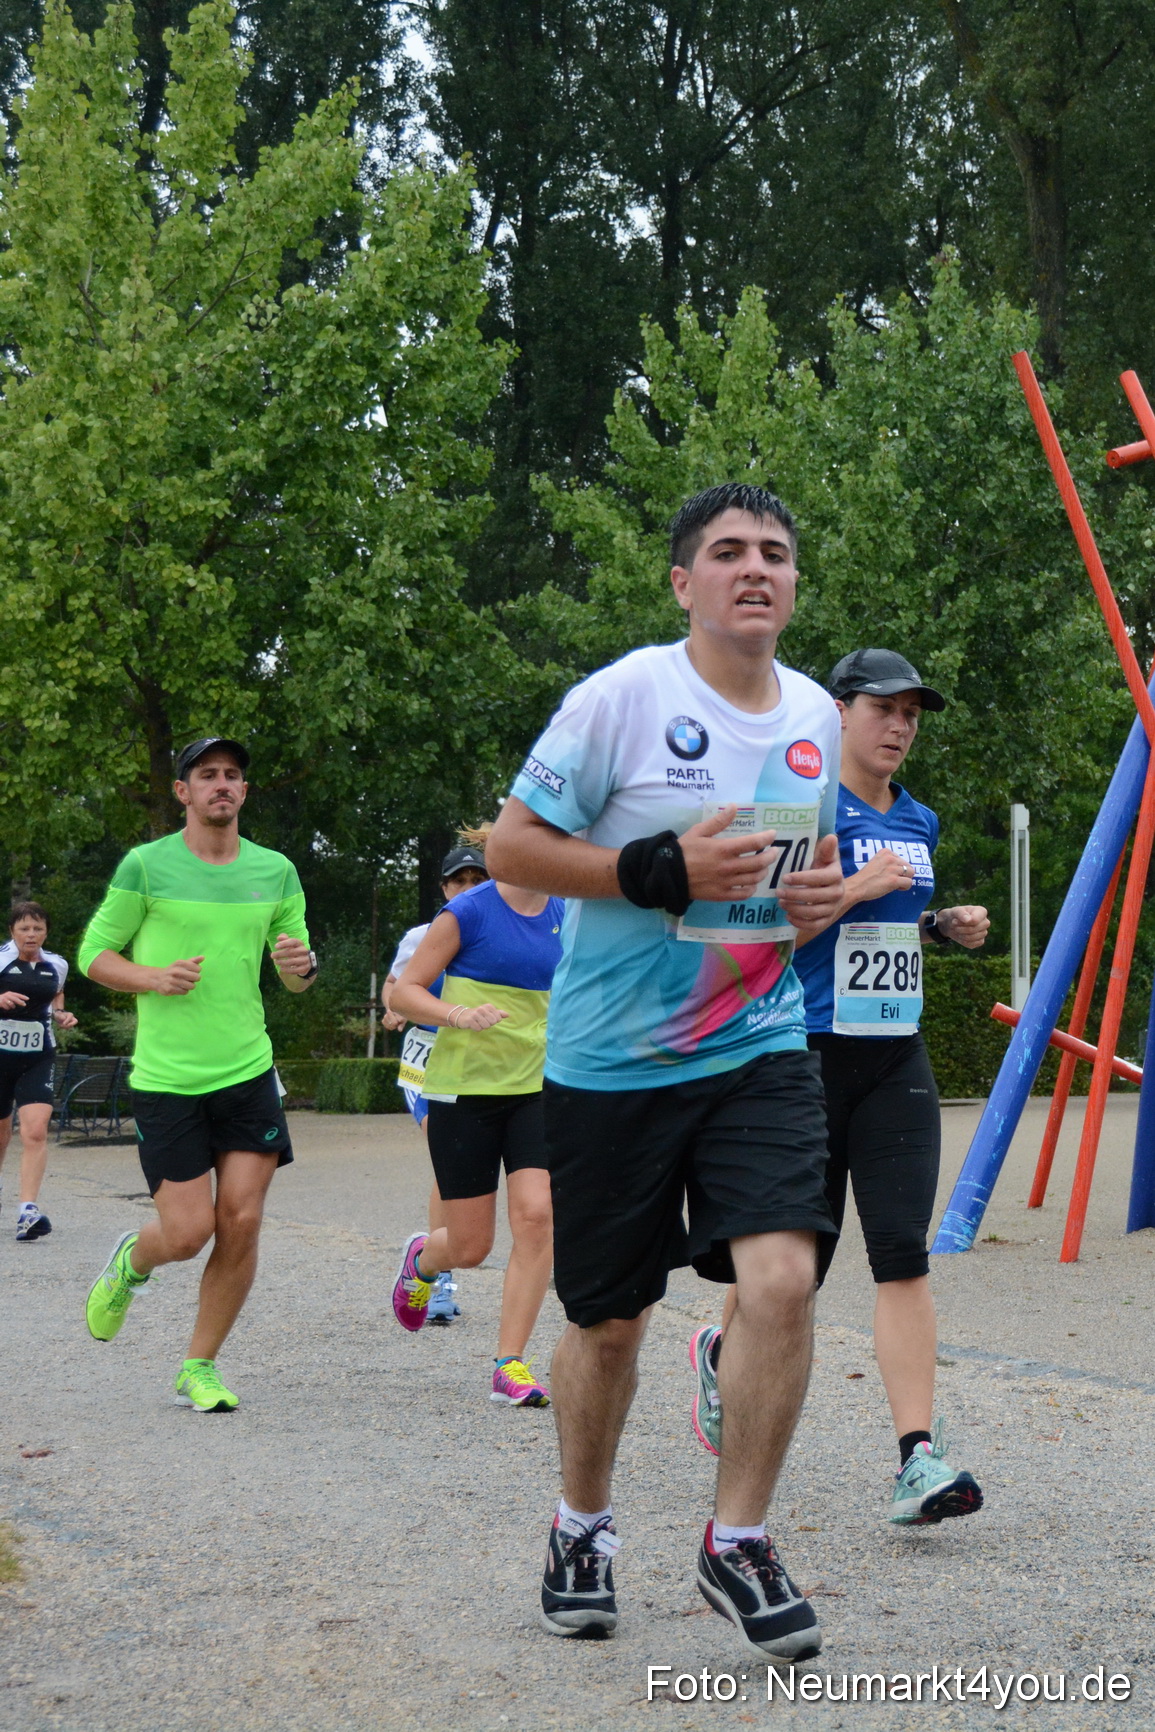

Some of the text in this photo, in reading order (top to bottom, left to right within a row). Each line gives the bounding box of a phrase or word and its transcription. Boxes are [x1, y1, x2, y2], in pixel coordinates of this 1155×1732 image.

[668, 716, 705, 733] BMW
[666, 768, 714, 781] PARTL
[667, 780, 715, 790] Neumarkt
[763, 808, 817, 824] BOCK
[853, 839, 931, 866] HUBER
[728, 904, 778, 923] Malek
[848, 950, 919, 991] 2289
[881, 1003, 900, 1018] Evi
[0, 1030, 40, 1048] 3013
